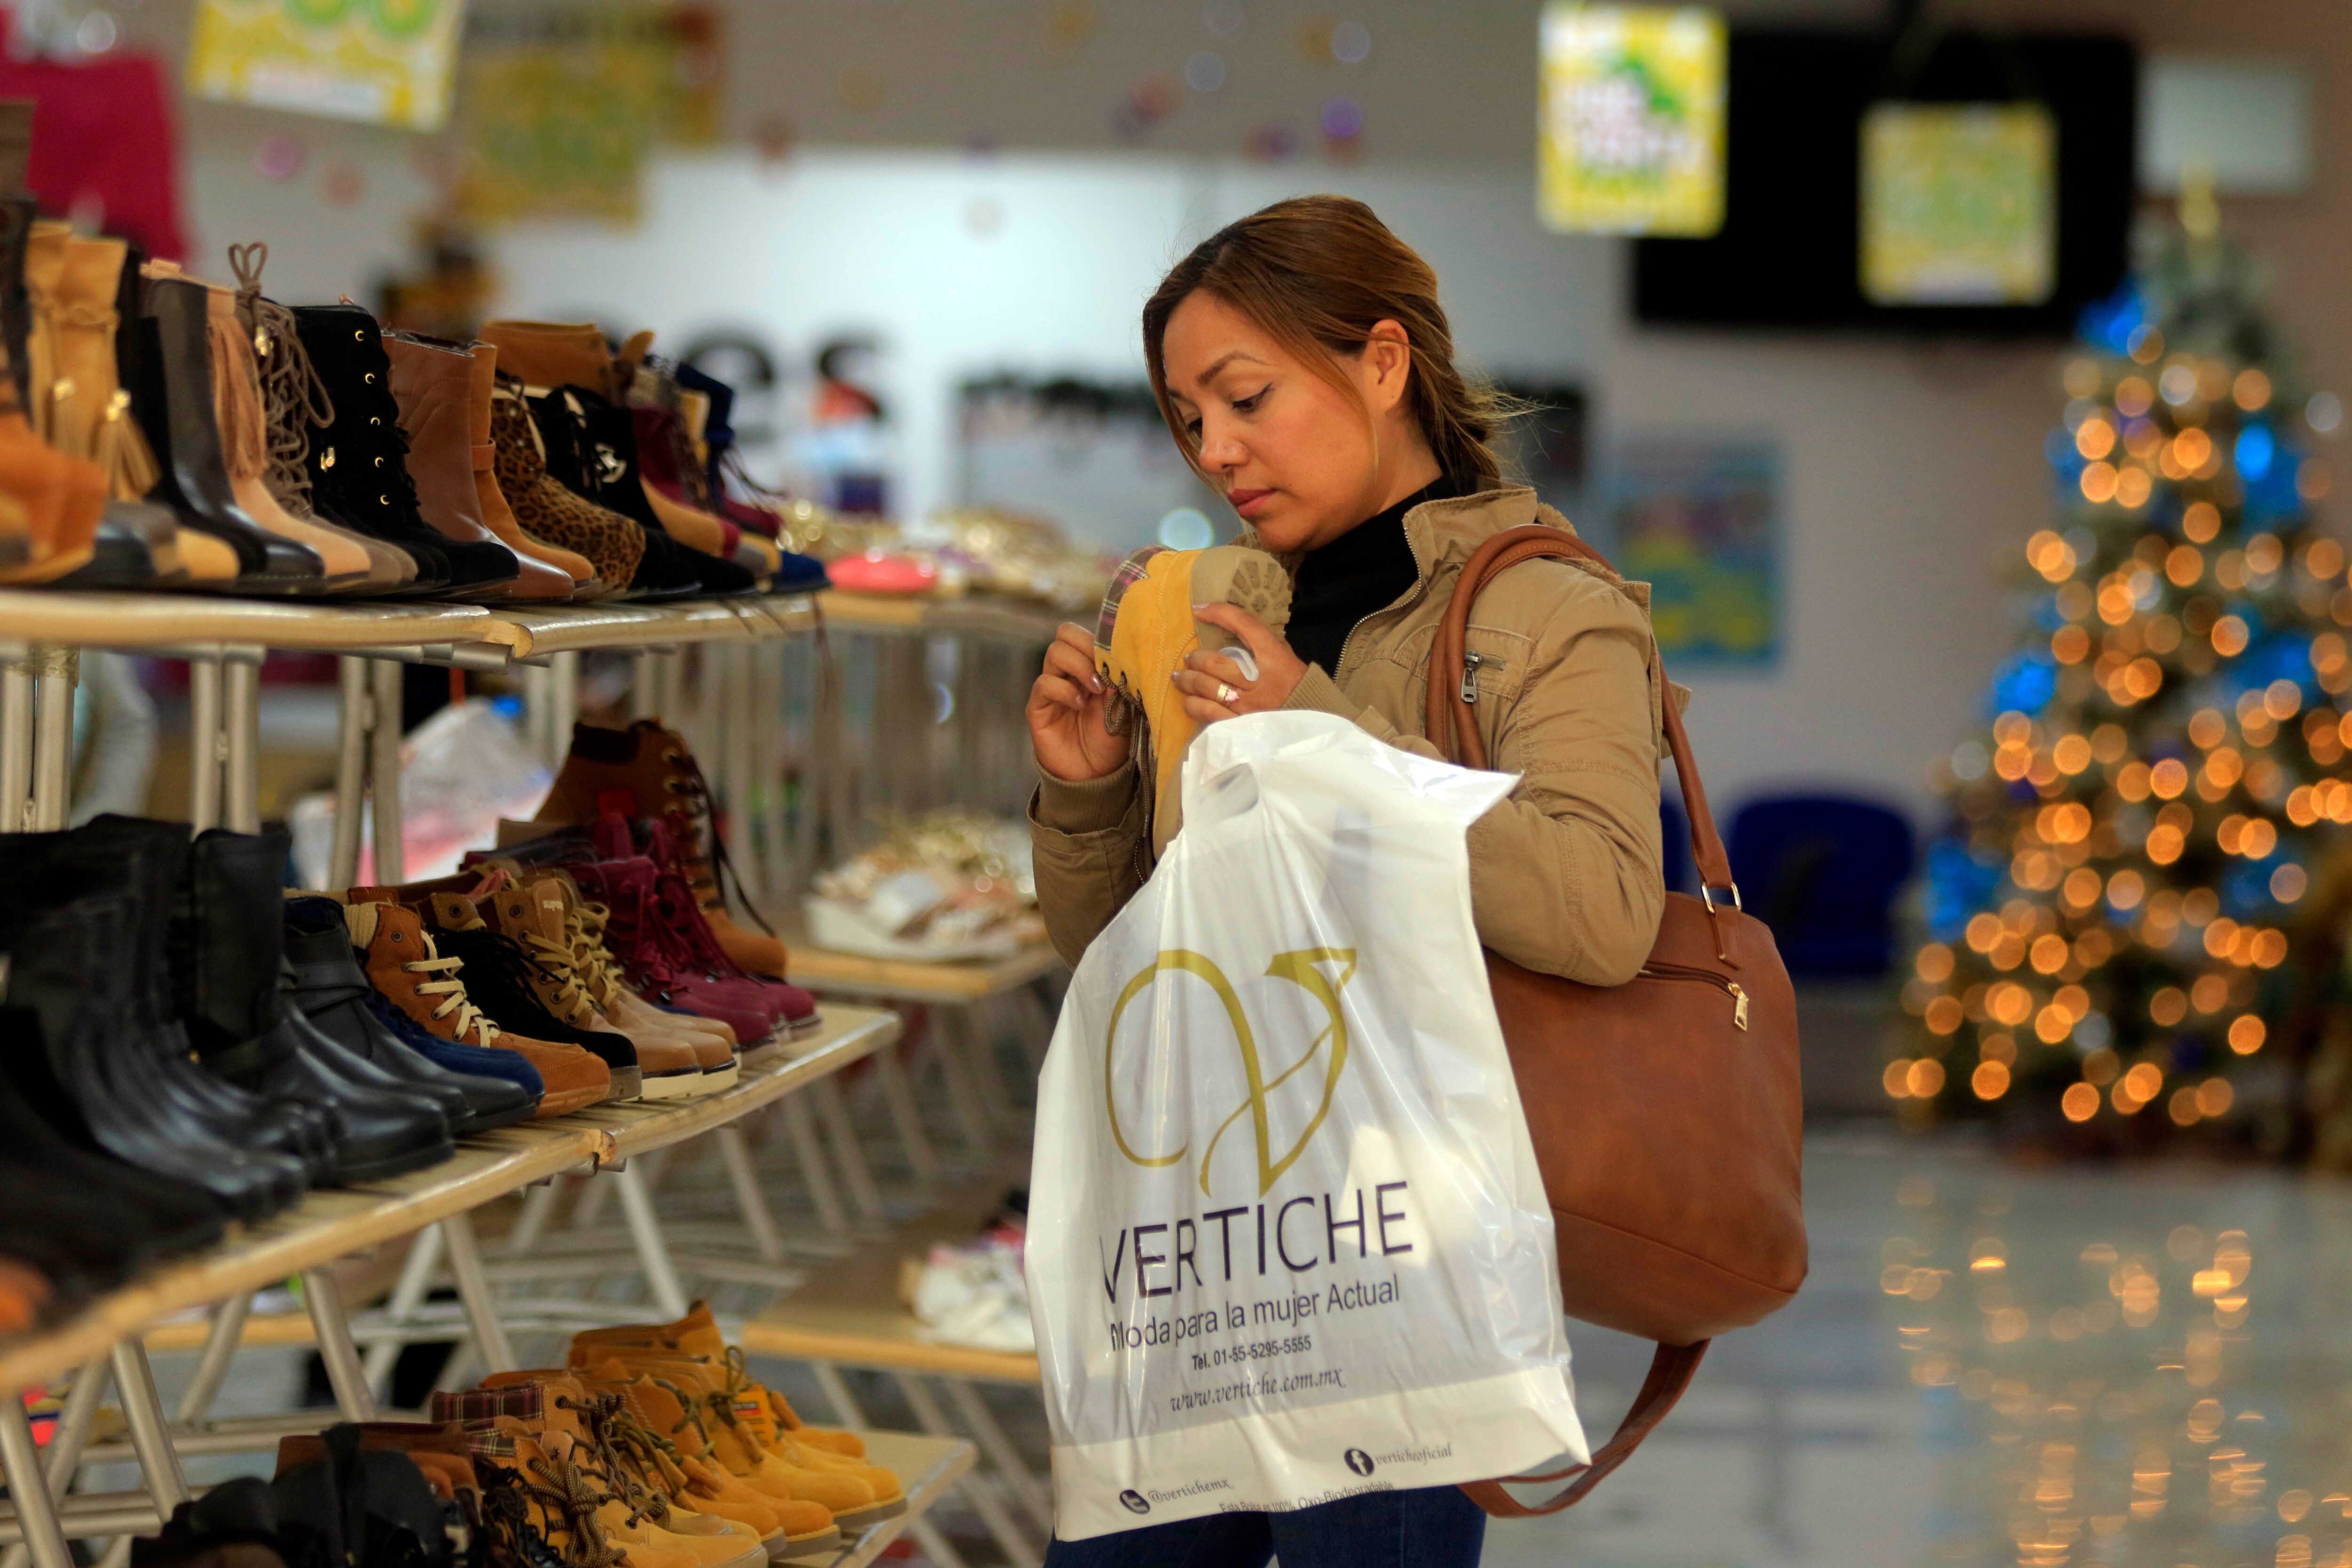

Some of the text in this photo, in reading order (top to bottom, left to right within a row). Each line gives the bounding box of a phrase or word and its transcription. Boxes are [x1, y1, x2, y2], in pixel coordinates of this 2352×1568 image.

[1099, 1181, 1413, 1304] VERTICHE
[1110, 1273, 1399, 1352] Moda para la mujer Actual
[1191, 1335, 1312, 1371] Tel. 01-55-5295-5555
[1170, 1369, 1347, 1411] www.vertiche.com.mx
[1375, 1442, 1453, 1466] verticheoficial
[1148, 1479, 1235, 1503] @vertichemx
[1297, 1480, 1394, 1510] Oxo-Biodegradable
